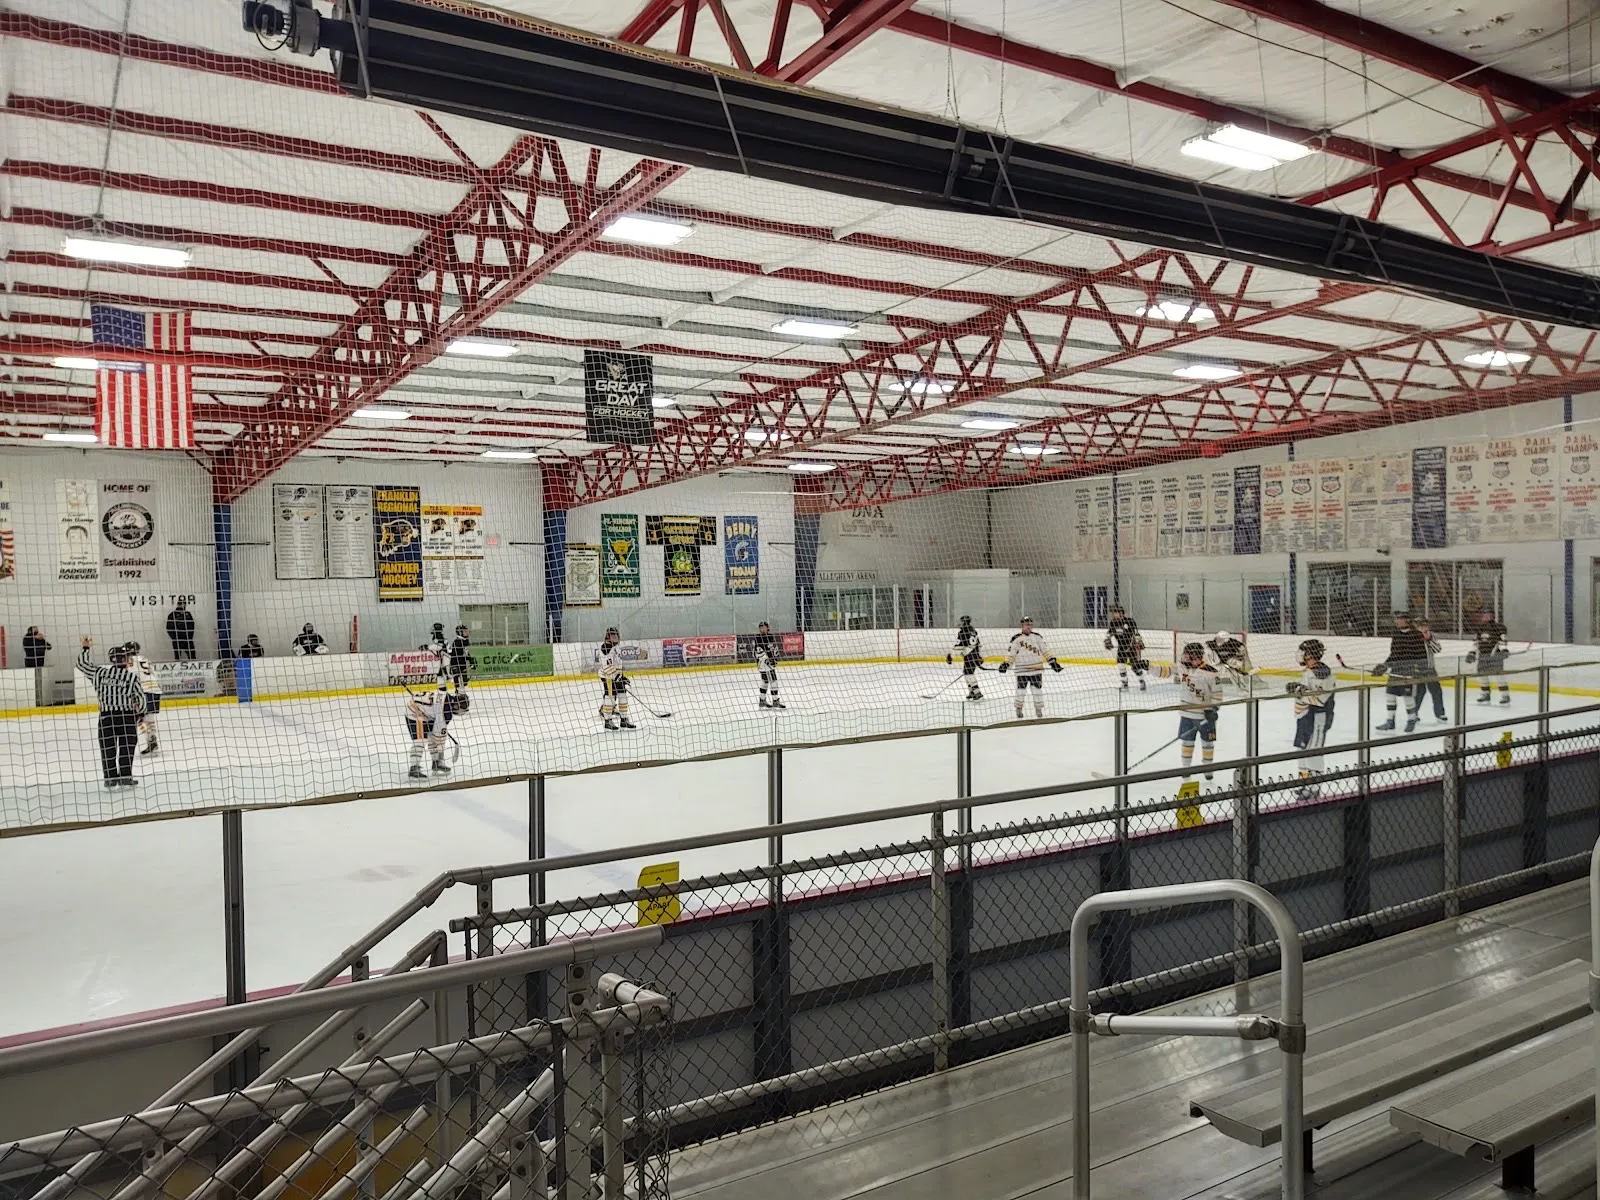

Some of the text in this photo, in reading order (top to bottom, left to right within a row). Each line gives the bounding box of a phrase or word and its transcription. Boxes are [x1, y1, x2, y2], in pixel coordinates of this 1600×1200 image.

[595, 380, 648, 394] GREAT
[607, 393, 639, 406] DAY
[612, 409, 650, 418] HOCKEY
[1523, 445, 1556, 456] CHAMPS
[1563, 443, 1598, 454] CHAMPS
[1485, 449, 1517, 459] CHAMPS
[103, 484, 151, 493] HOME OF
[377, 491, 418, 501] FRANKLIN
[378, 502, 419, 513] REGIONAL
[663, 526, 698, 534] GATEWAY
[103, 558, 156, 566] Established
[380, 563, 419, 574] PANTHER
[119, 570, 141, 578] 1992
[819, 572, 876, 581] ALLEGHENY ARENA
[382, 574, 417, 585] HOCKEY
[667, 577, 699, 586] HOCKEY
[686, 642, 735, 657] SIGNS
[390, 653, 440, 664] Advertise
[483, 651, 533, 665] cricket
[153, 661, 214, 672] LAY SAFE
[403, 664, 428, 674] Here
[160, 681, 205, 691] merisafe
